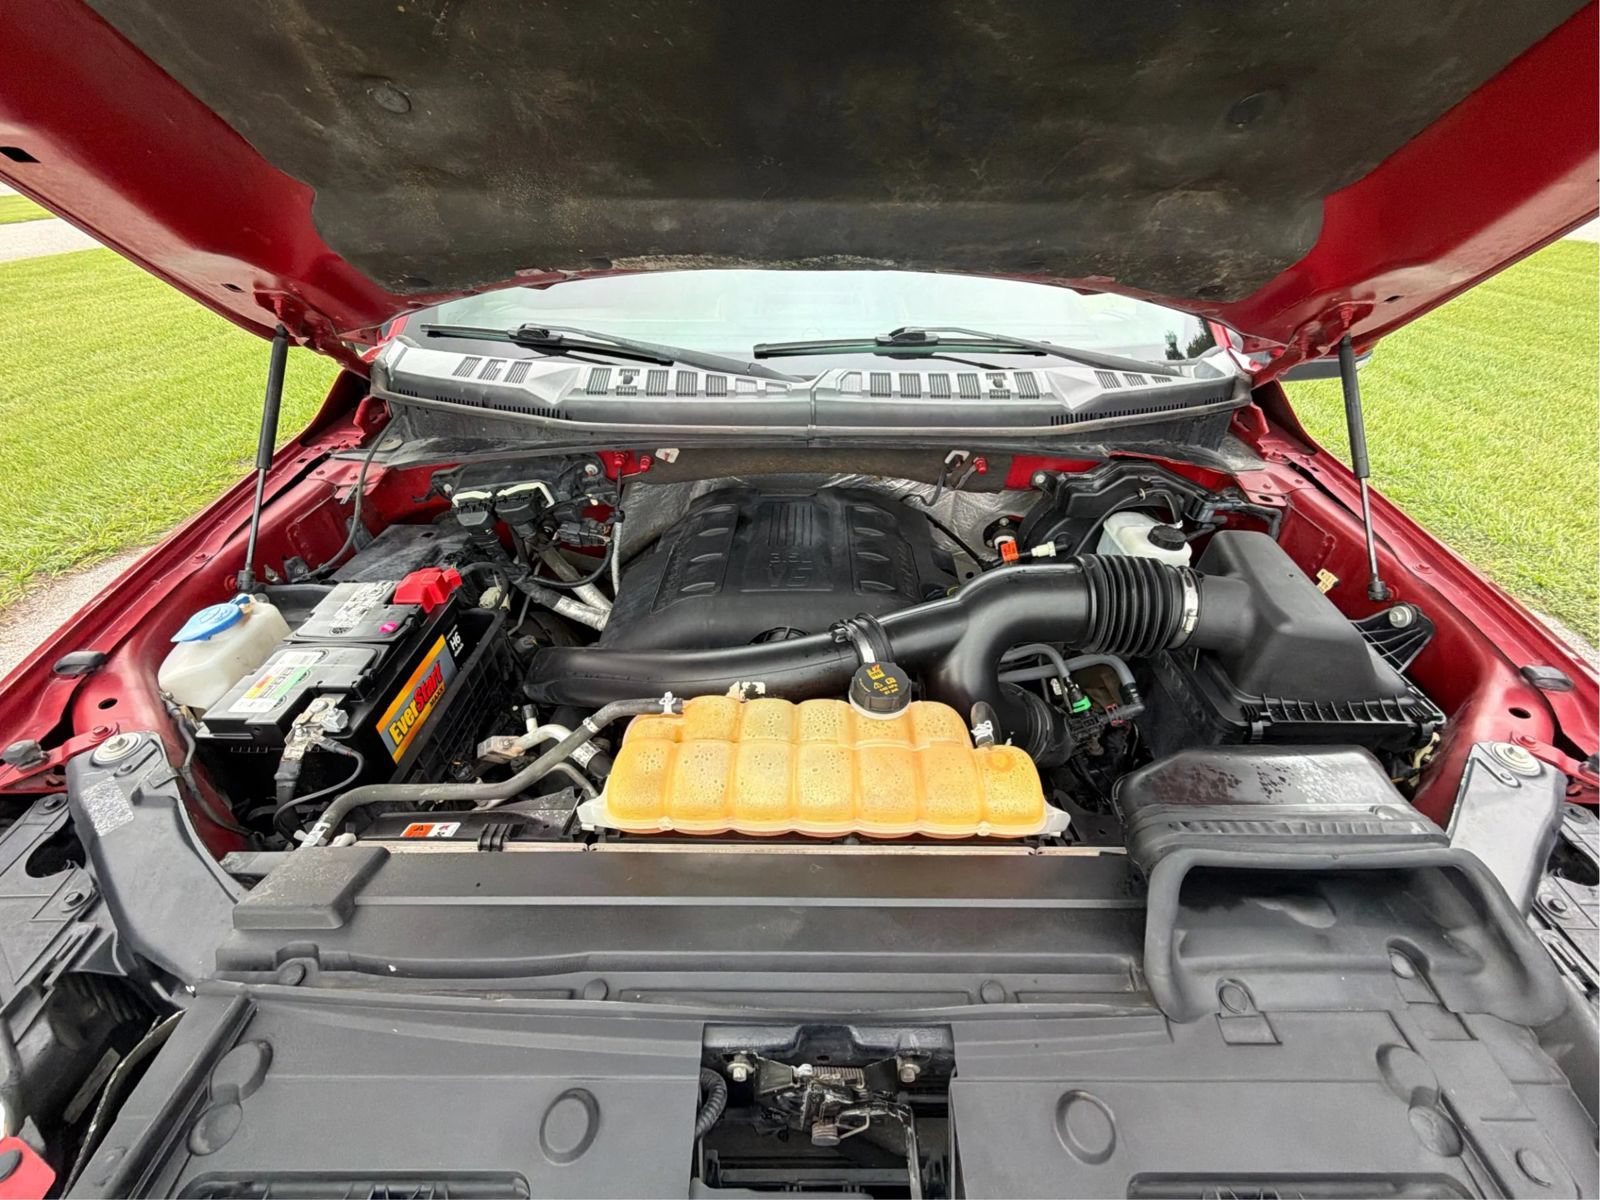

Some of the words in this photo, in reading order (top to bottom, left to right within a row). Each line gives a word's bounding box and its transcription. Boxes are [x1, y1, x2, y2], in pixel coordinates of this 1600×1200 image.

[449, 632, 461, 650] H6
[388, 662, 443, 746] EverStart
[429, 686, 445, 706] MAXX
